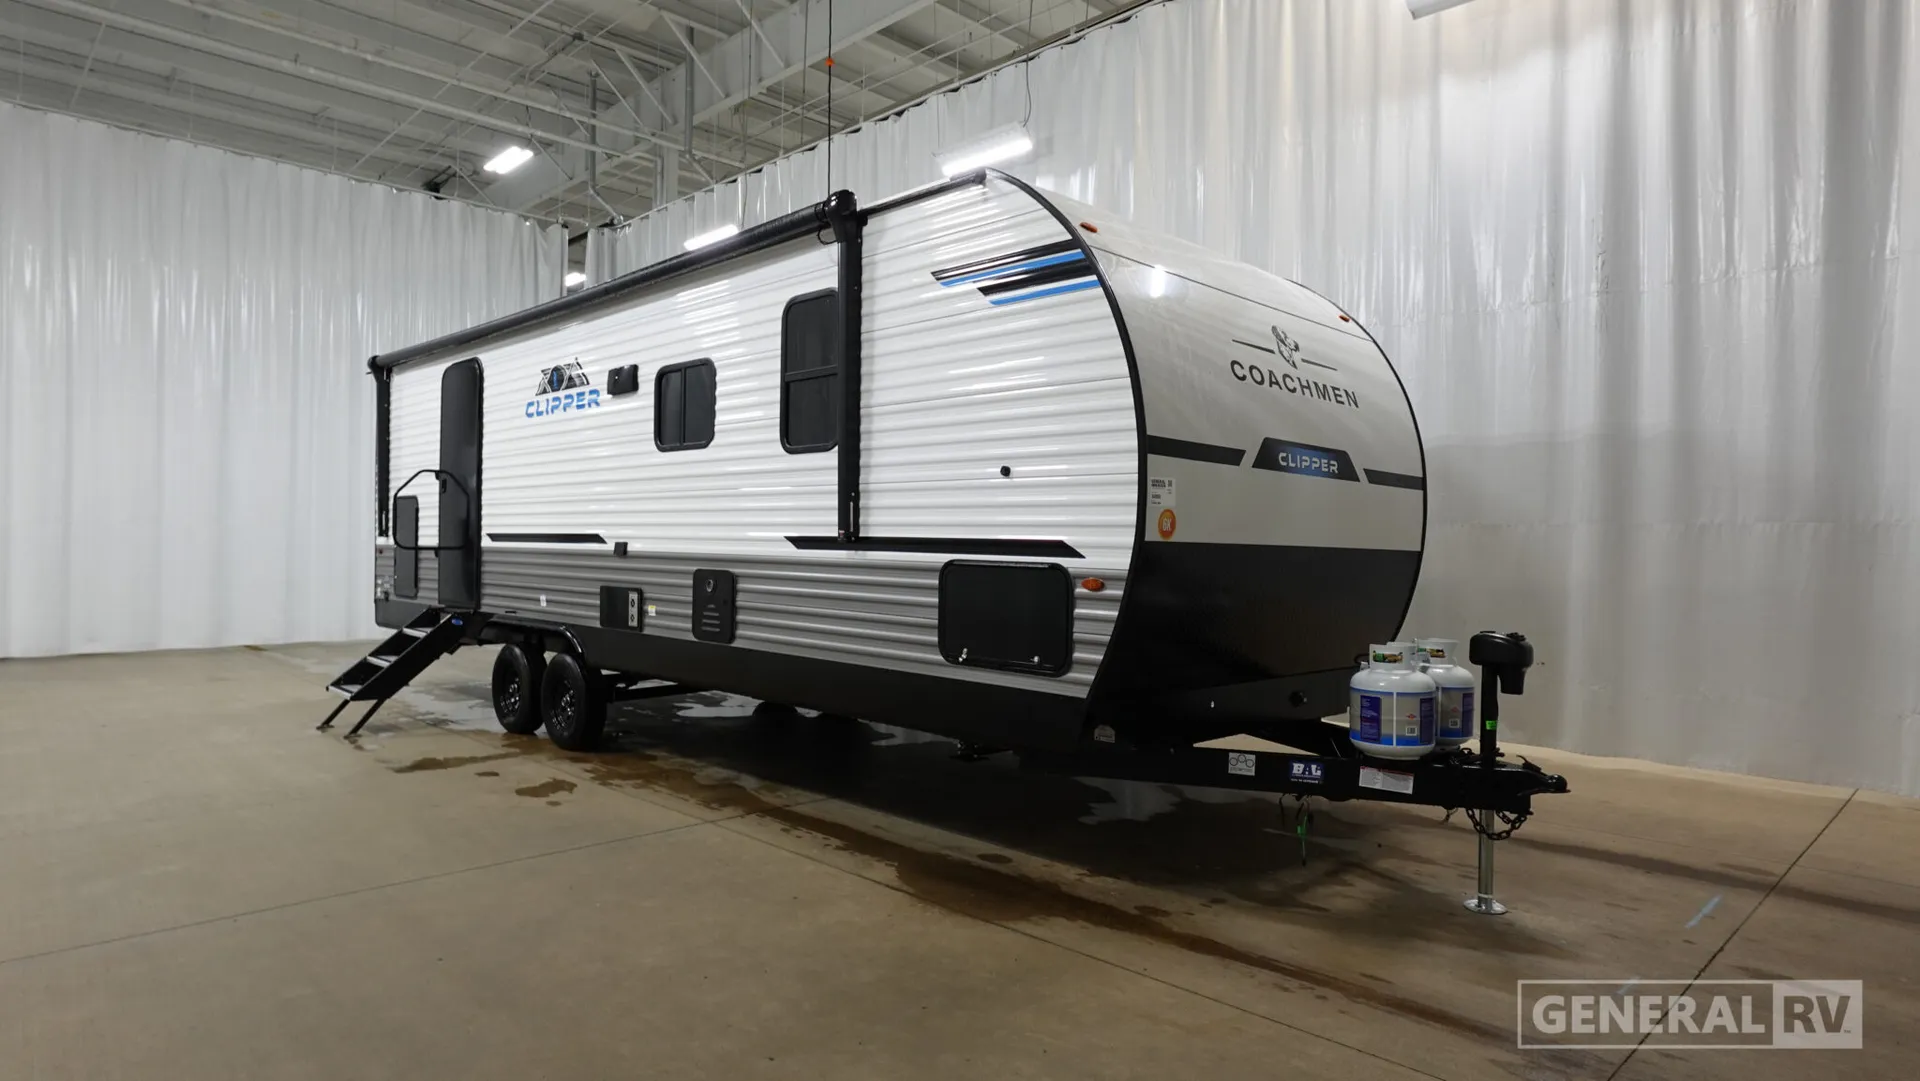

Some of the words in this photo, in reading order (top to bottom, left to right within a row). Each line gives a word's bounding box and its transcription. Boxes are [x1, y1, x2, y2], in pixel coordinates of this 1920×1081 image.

[1230, 359, 1359, 408] COACHMEN
[525, 388, 600, 418] CLIPPER
[1278, 452, 1339, 474] CLIPPER
